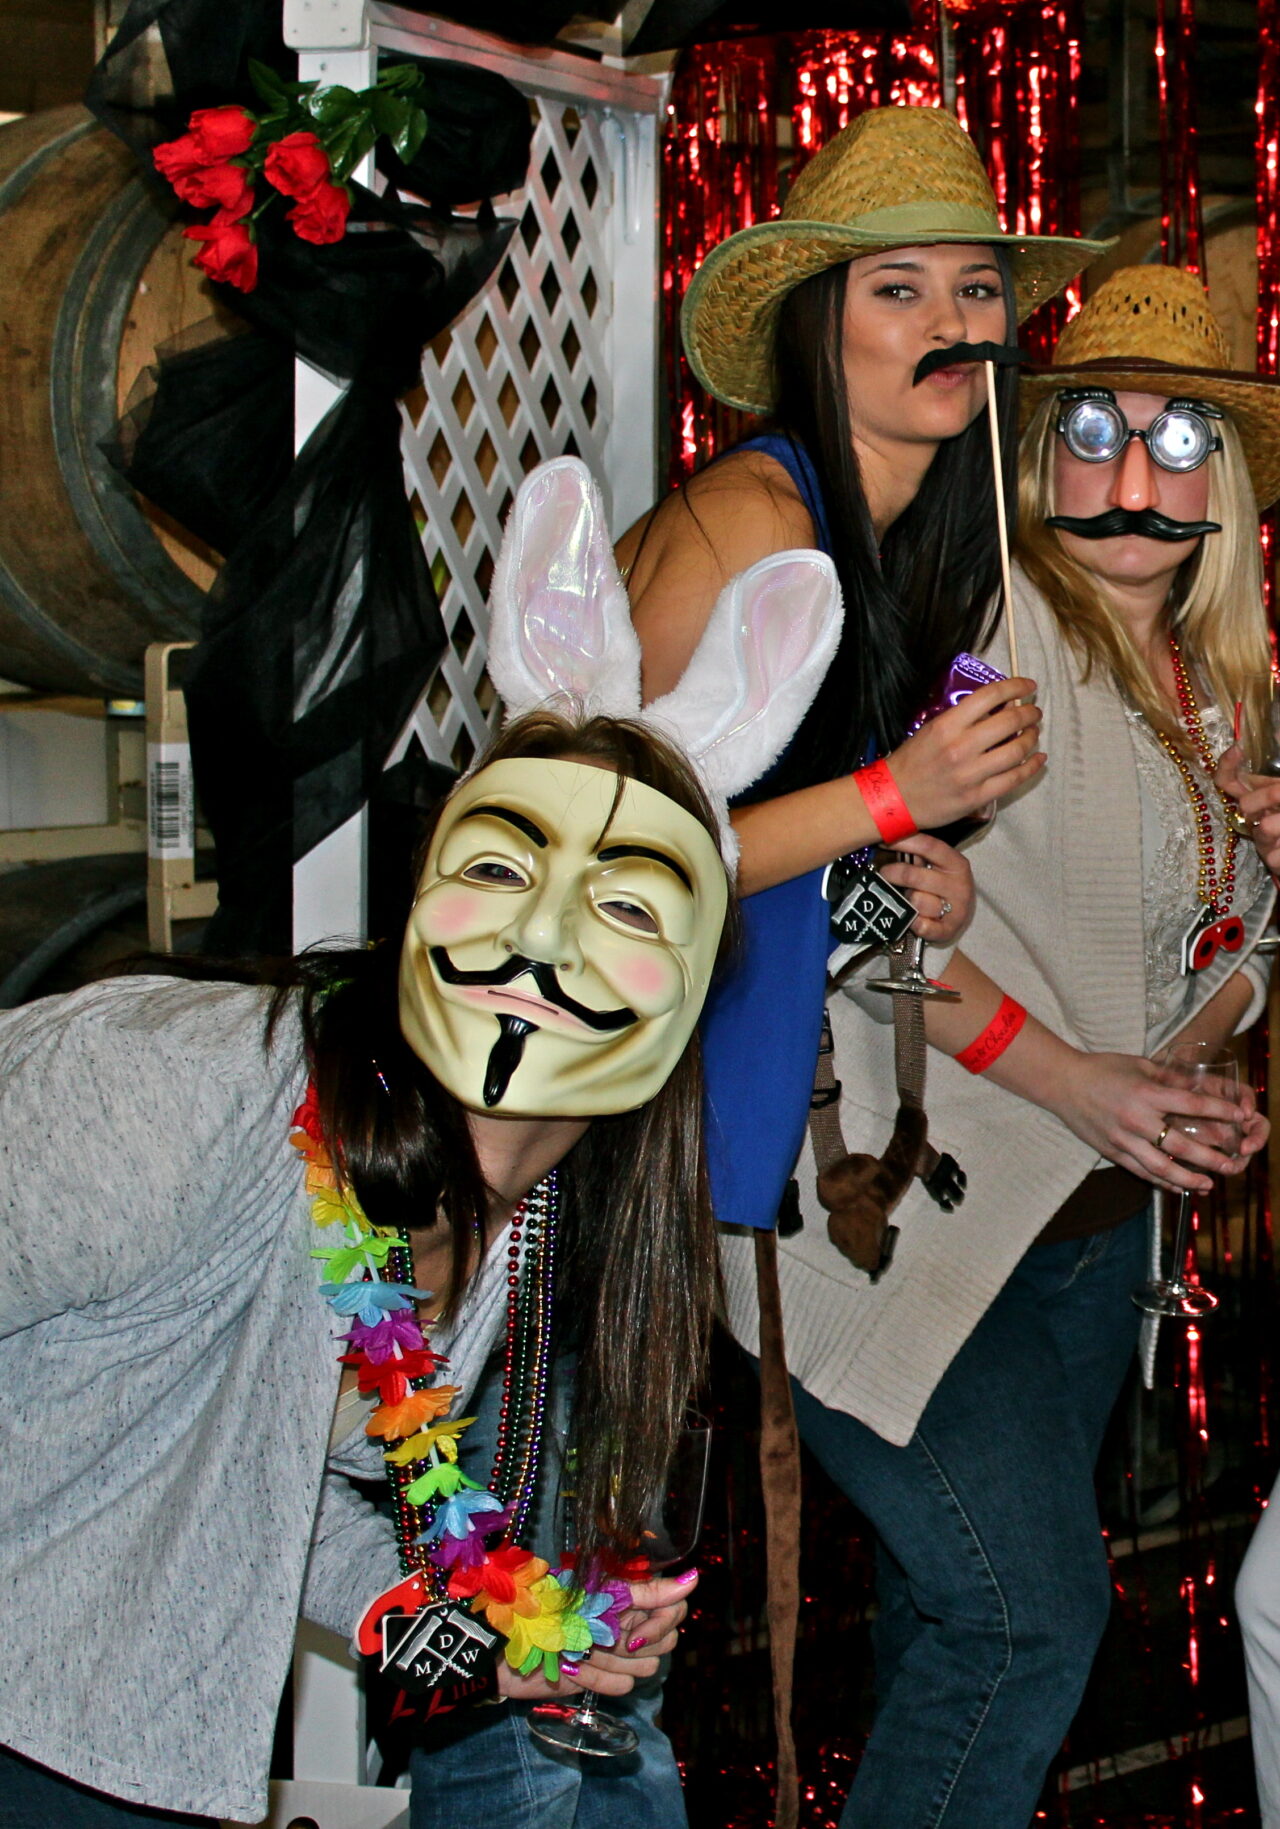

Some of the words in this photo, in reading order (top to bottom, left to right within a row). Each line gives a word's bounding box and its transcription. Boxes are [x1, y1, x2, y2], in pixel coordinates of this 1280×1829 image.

[867, 771, 896, 818] Chocte
[862, 900, 874, 913] D
[845, 920, 858, 932] M
[879, 917, 894, 929] W
[439, 1634, 454, 1649] D
[415, 1661, 432, 1677] M
[461, 1649, 480, 1664] W
